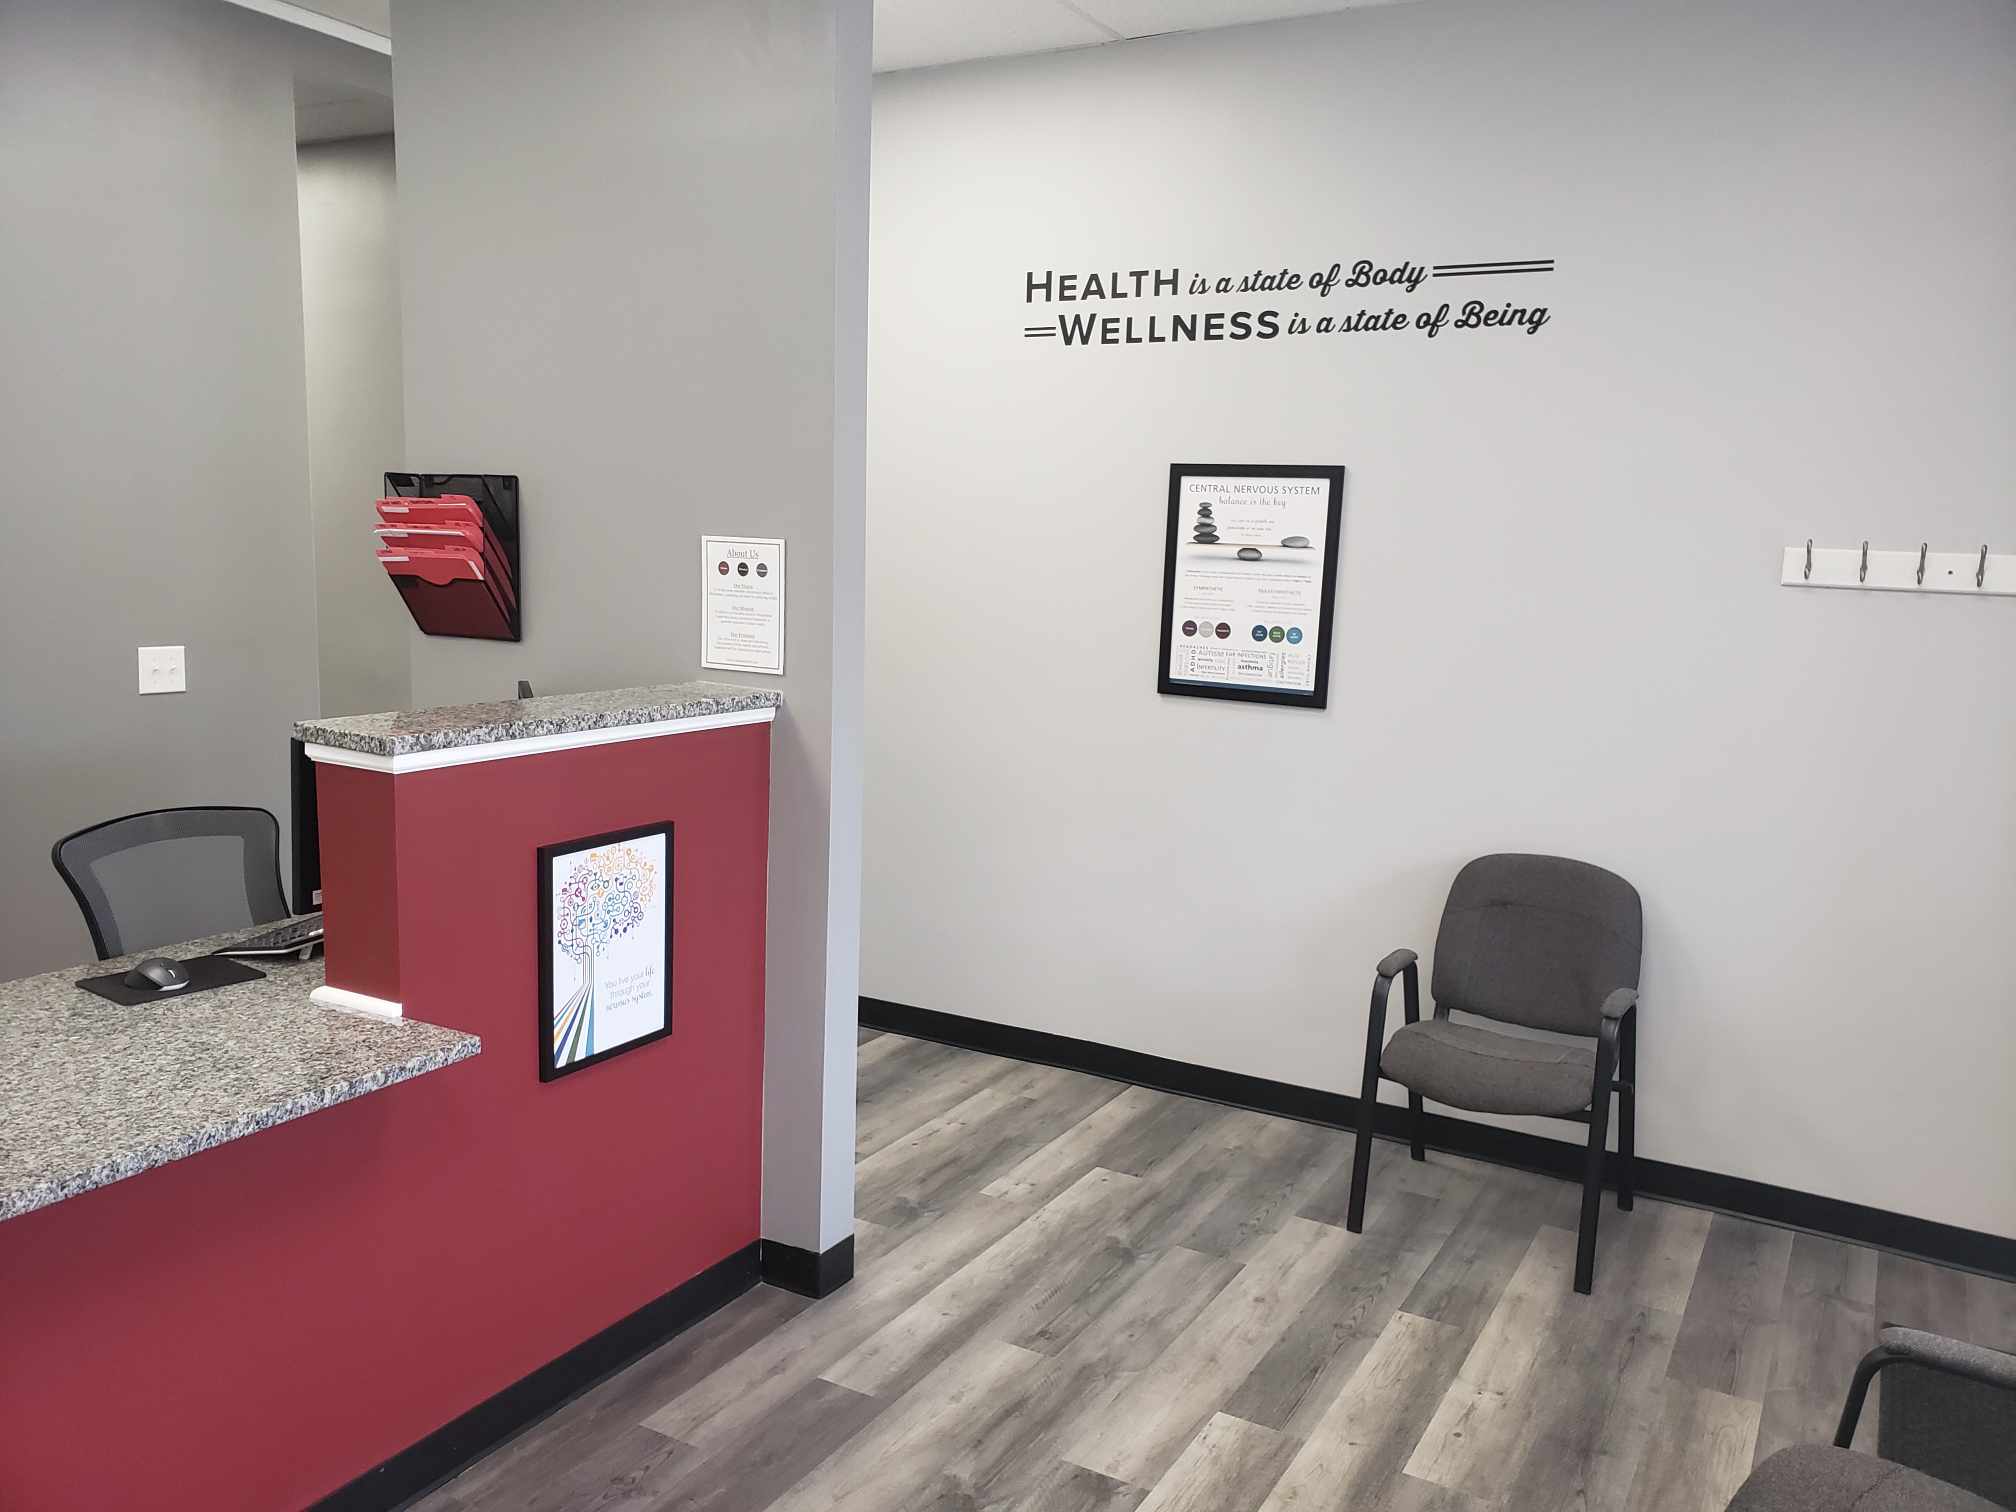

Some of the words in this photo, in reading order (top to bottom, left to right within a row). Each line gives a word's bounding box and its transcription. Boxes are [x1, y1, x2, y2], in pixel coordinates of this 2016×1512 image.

[1026, 268, 1179, 303] HEALTH
[1188, 273, 1211, 295] is
[1215, 276, 1234, 294] a
[1236, 268, 1303, 293] state
[1309, 263, 1341, 297] of
[1345, 260, 1427, 293] Body
[1058, 310, 1280, 346] WELLNESS
[1288, 312, 1311, 335] is
[1316, 317, 1336, 333] a
[1338, 308, 1410, 333] state
[1415, 303, 1451, 338] of
[1454, 300, 1551, 335] Being
[1189, 484, 1231, 494] CENTRAL
[1234, 484, 1279, 495] NERVOUS
[1282, 485, 1321, 496] SYSTEM
[1219, 495, 1247, 505] balance
[1260, 496, 1271, 506] the
[727, 547, 748, 558] About
